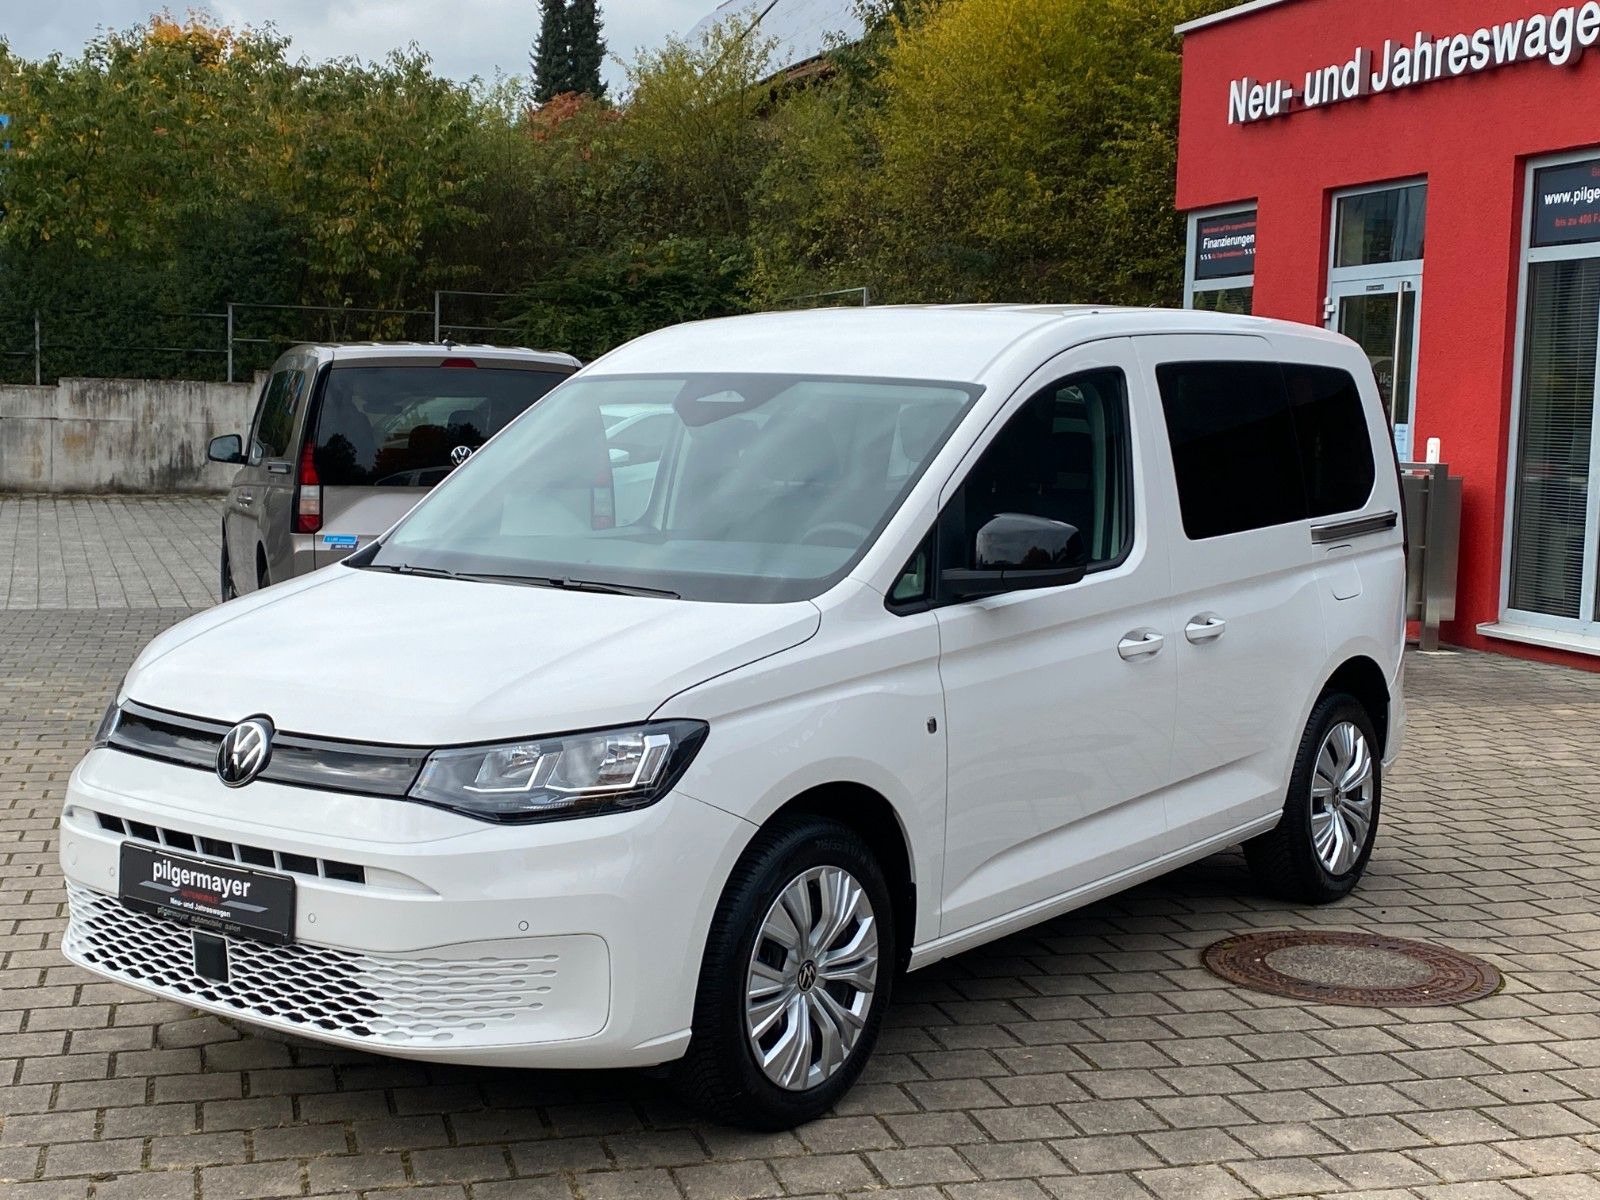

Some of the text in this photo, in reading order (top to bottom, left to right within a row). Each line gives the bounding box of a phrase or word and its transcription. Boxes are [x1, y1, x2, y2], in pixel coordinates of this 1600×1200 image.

[1228, 0, 1600, 125] Neu- und Jahreswage
[1203, 234, 1255, 249] Finanzierungen
[153, 859, 251, 898] pilgermayer
